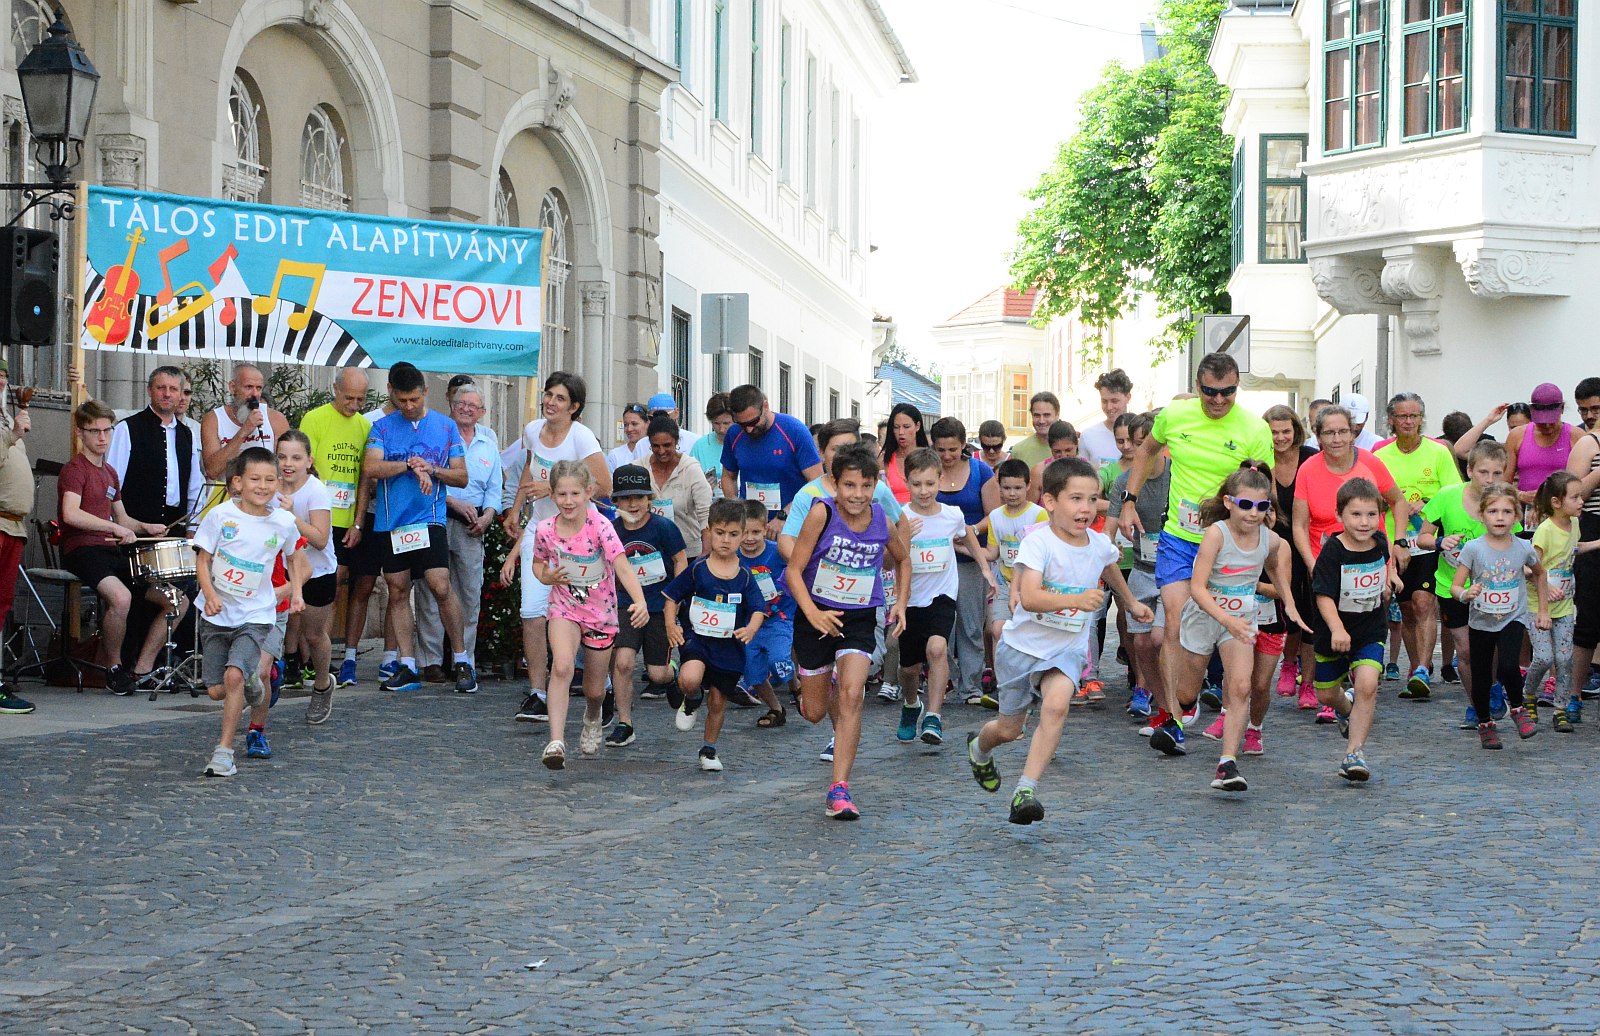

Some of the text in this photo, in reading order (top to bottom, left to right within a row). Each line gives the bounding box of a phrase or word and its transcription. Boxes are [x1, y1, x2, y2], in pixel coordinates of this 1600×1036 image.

[101, 196, 528, 265] TÁLOS EDIT ALAPÍTVÁNY
[351, 277, 523, 327] ZENEOVI
[392, 336, 525, 353] www.taloseditalapitvany.com
[617, 475, 647, 485] OAKLEY
[335, 490, 349, 502] 48
[758, 491, 765, 502] 5
[399, 531, 421, 545] 102
[831, 535, 880, 554] BE THE
[825, 546, 876, 569] BEST
[920, 551, 934, 563] 16
[1007, 549, 1019, 560] 58
[223, 568, 245, 586] 42
[578, 565, 588, 577] 7
[637, 566, 647, 577] 4
[833, 575, 857, 592] 37
[1353, 572, 1380, 589] 105
[1483, 591, 1510, 605] 103
[700, 611, 719, 627] 26
